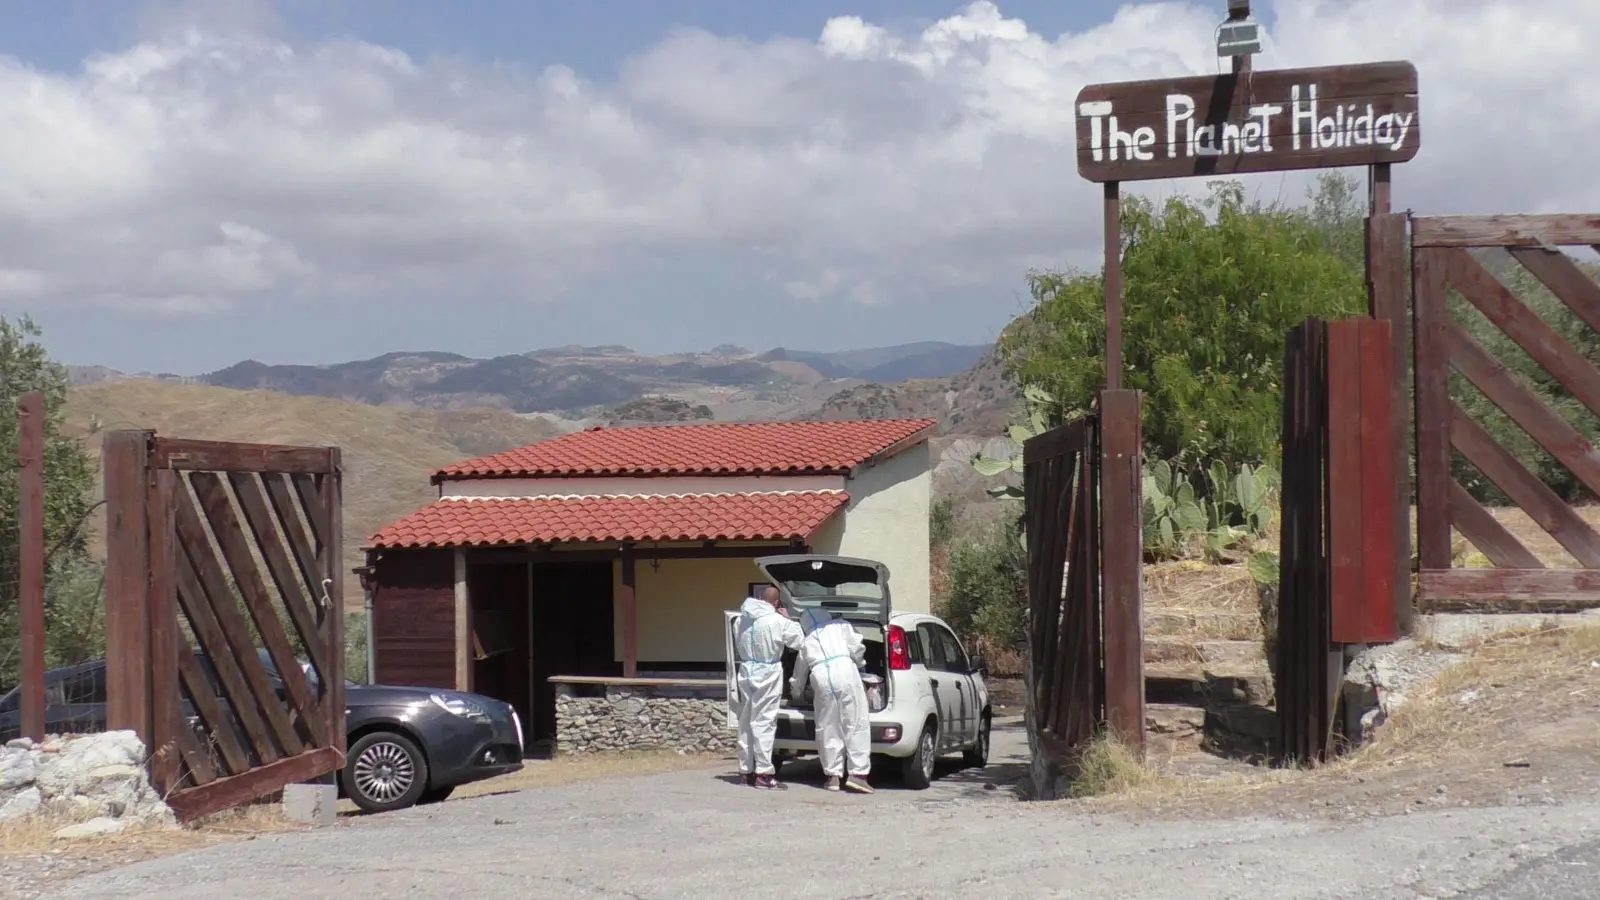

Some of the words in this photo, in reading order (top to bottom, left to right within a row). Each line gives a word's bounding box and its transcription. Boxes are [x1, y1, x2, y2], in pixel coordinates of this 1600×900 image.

[1079, 101, 1156, 161] The
[1166, 94, 1283, 158] Planet
[1291, 84, 1413, 151] Holiday
